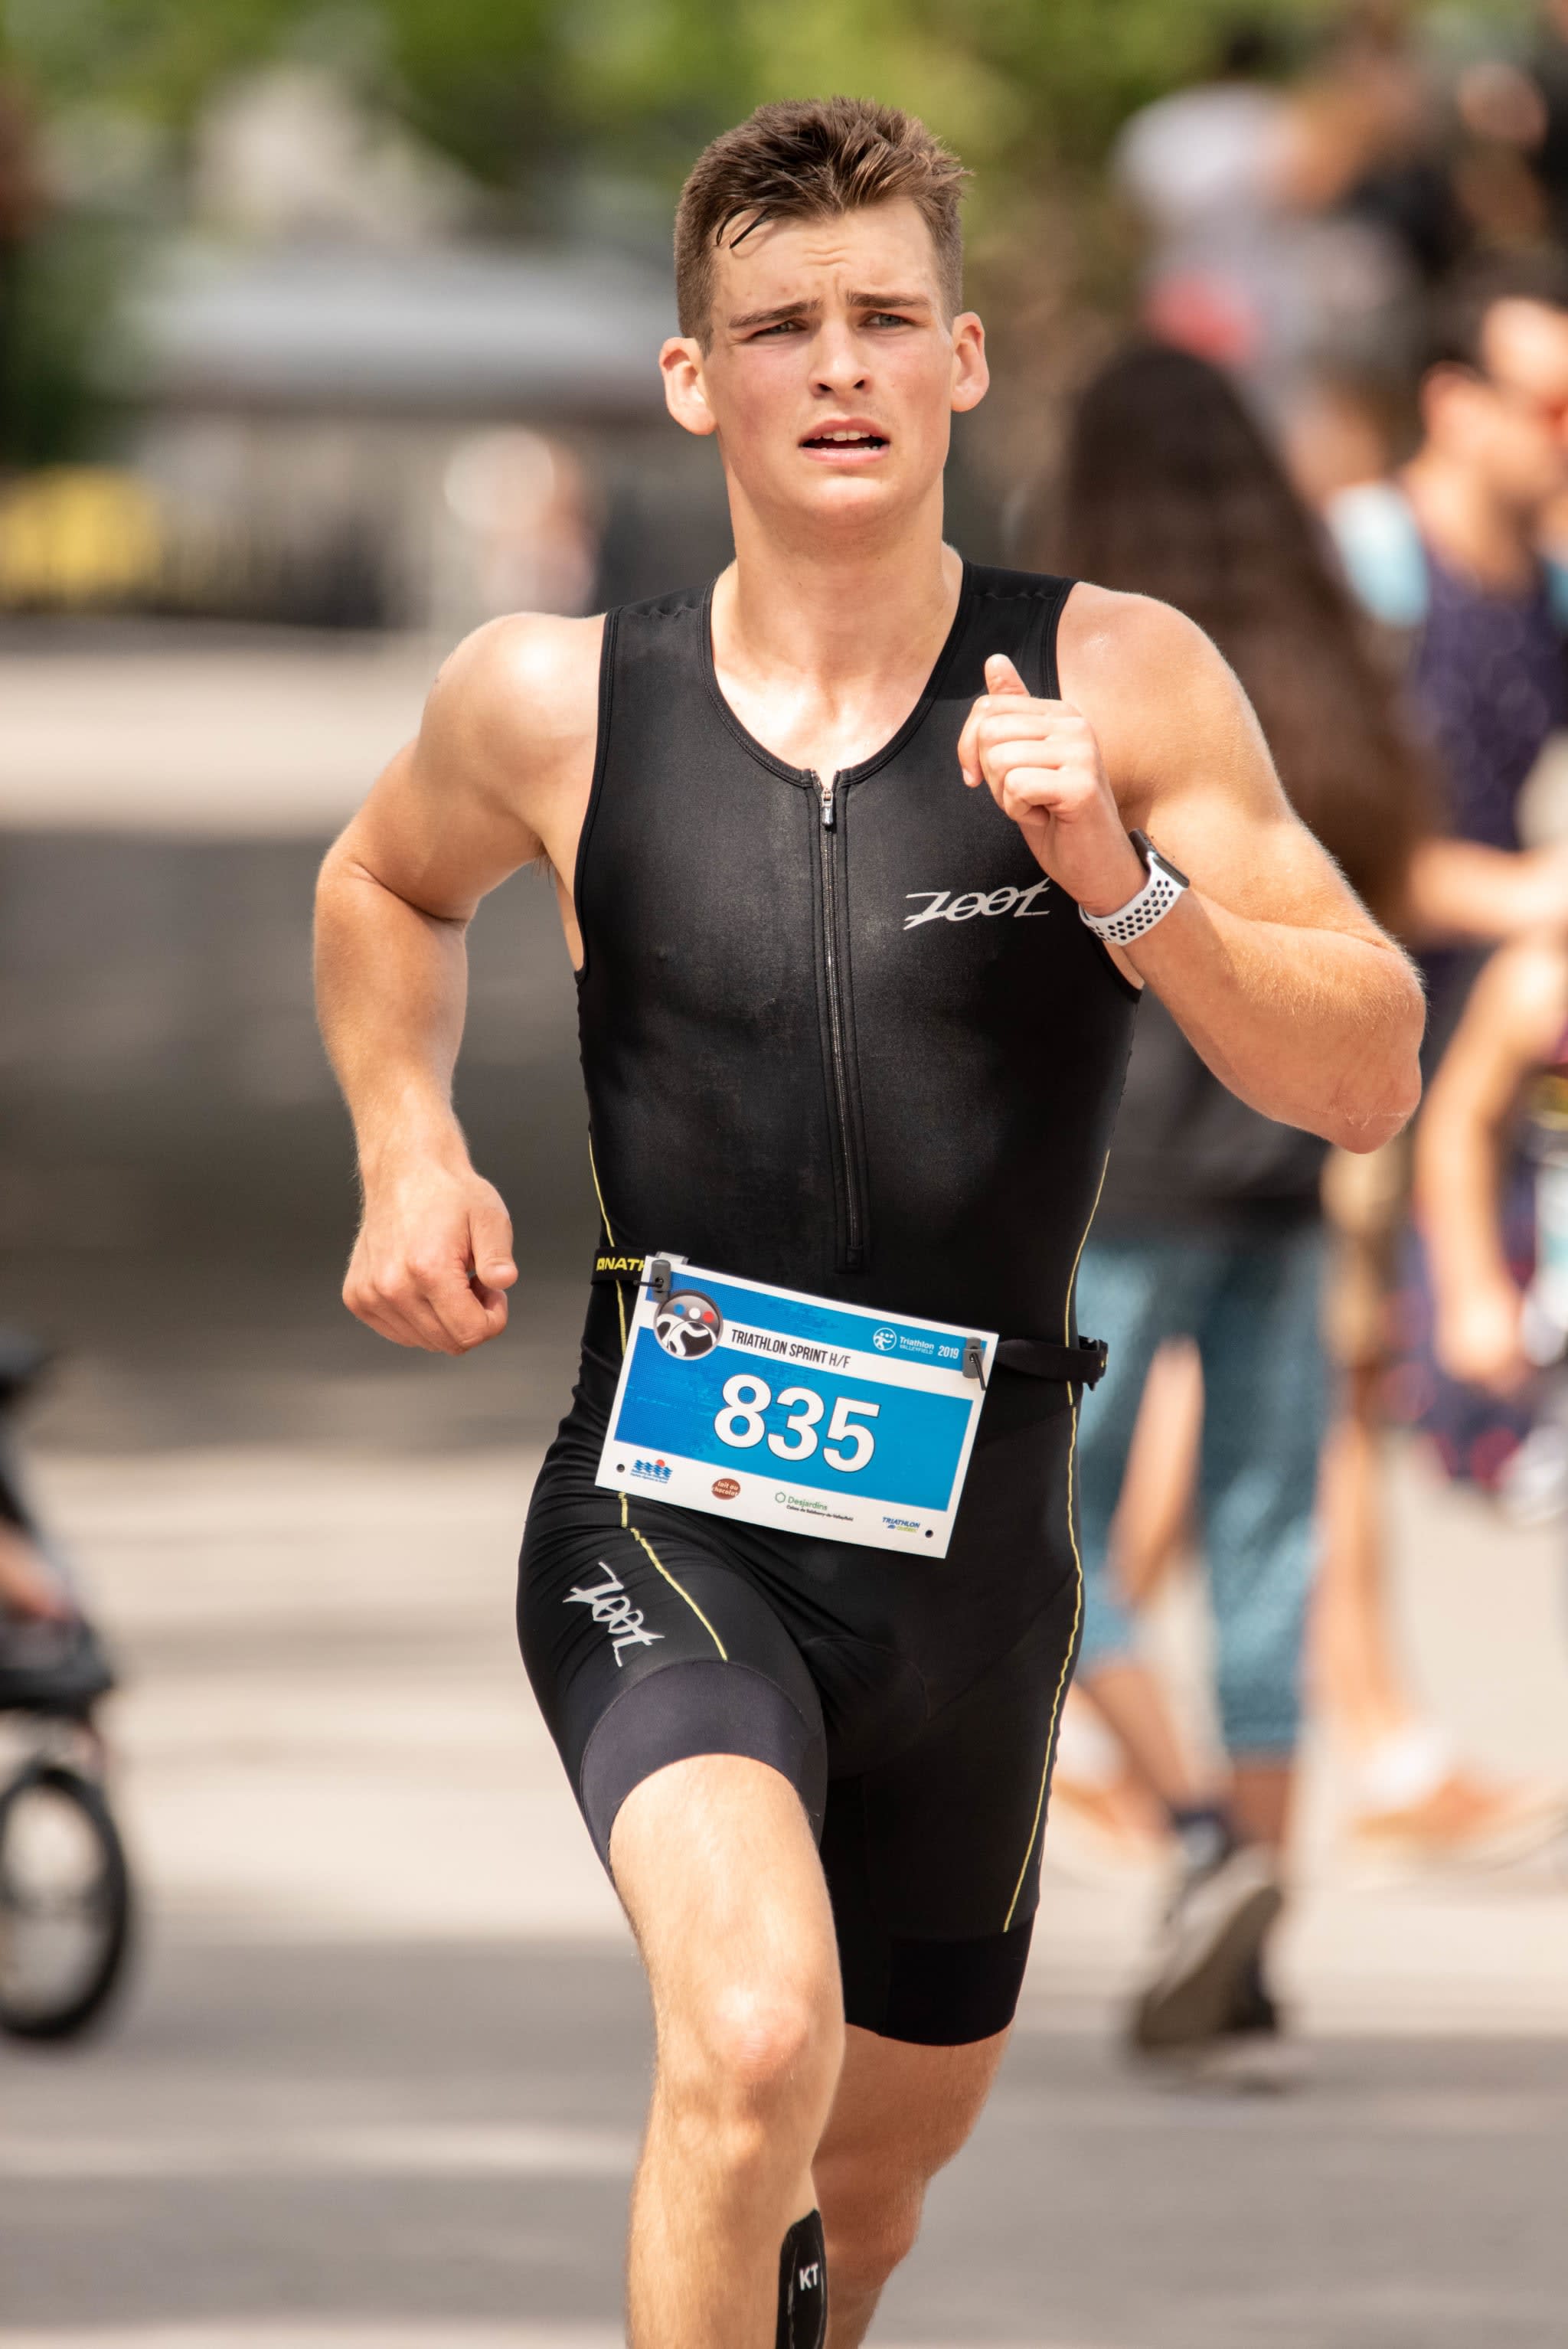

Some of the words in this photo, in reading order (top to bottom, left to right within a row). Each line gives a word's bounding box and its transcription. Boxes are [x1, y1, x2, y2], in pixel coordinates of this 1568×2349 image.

[731, 1328, 788, 1355] TRIATHLON
[789, 1343, 828, 1364] SPRINT
[828, 1352, 851, 1368] H/F
[899, 1336, 935, 1350] Triathlon
[937, 1345, 960, 1359] 2019
[714, 1373, 882, 1473] 835
[788, 1495, 828, 1511] Desjardins
[882, 1516, 921, 1528] TRIATHLON
[799, 2262, 819, 2291] KT
